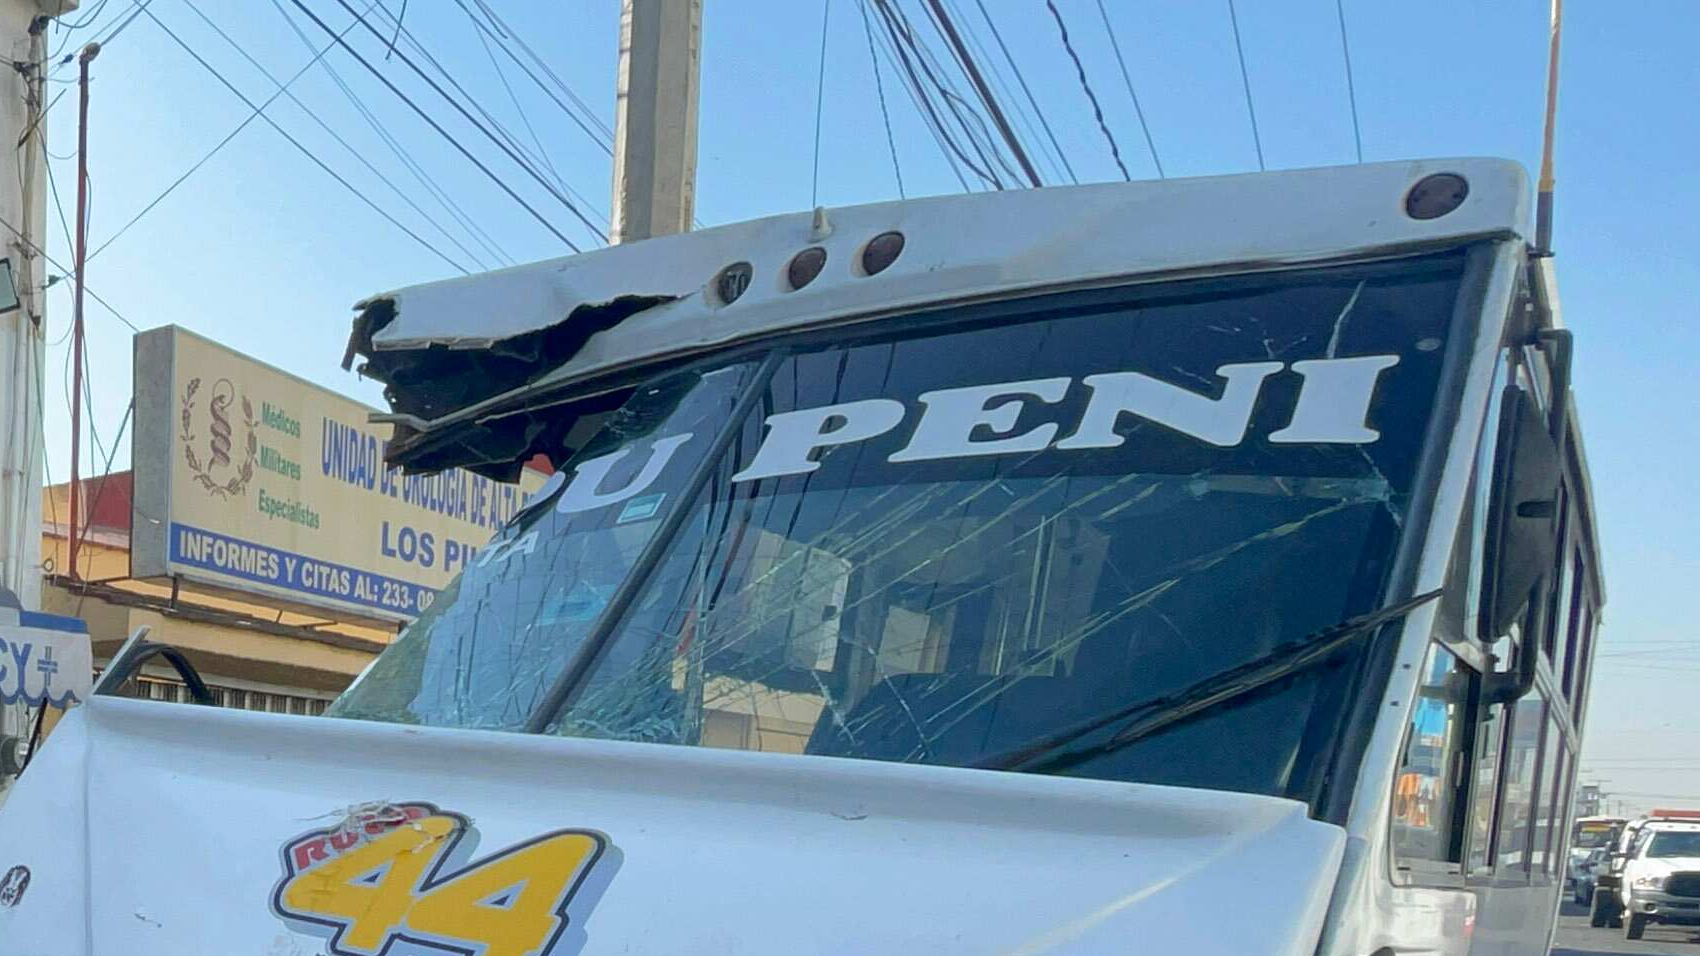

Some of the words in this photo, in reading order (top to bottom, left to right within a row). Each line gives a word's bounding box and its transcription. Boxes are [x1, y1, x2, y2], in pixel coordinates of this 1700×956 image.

[322, 416, 377, 490] UNIDAD
[732, 355, 1400, 483] PENI
[259, 488, 320, 530] Especialistas
[382, 521, 435, 567] LOS
[180, 530, 279, 579] INFORMES
[285, 557, 297, 582] Y
[302, 562, 350, 595] CITAS
[354, 575, 378, 602] AL:
